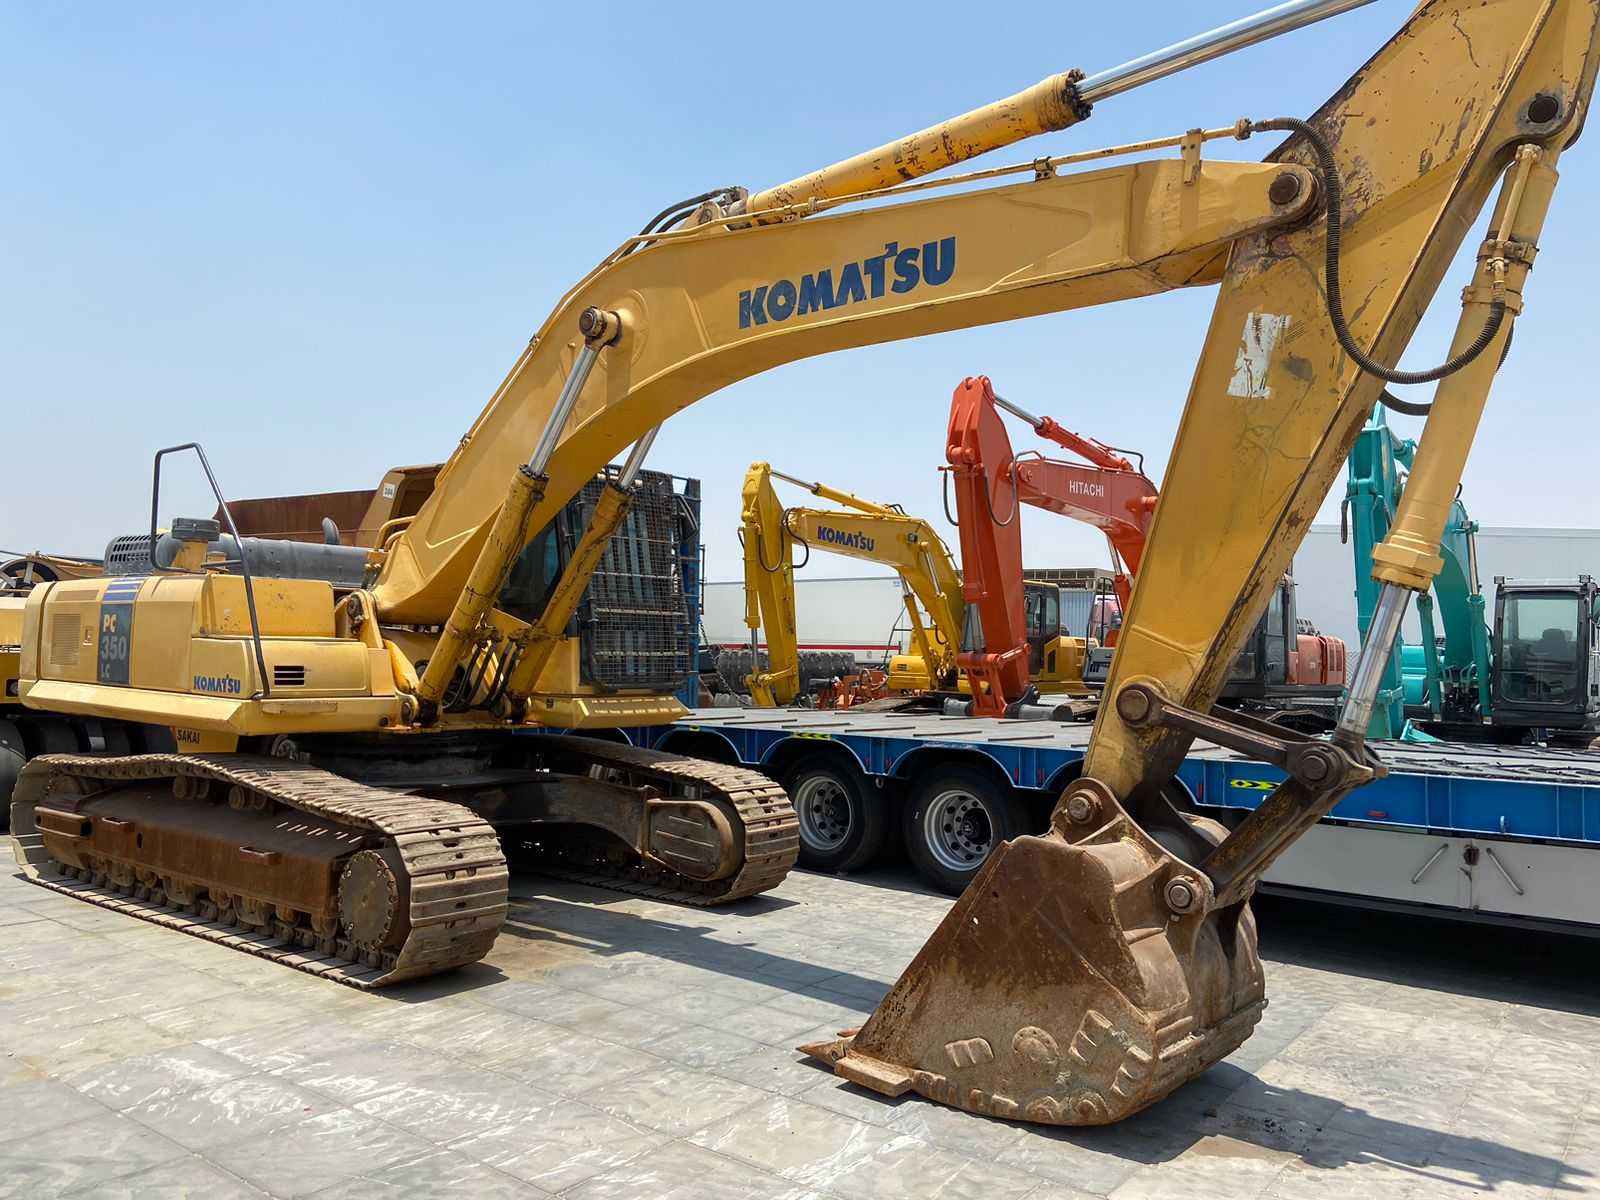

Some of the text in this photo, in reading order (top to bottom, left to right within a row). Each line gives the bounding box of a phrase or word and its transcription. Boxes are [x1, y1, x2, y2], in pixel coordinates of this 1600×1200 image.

[738, 236, 956, 329] KOMATSU
[1069, 480, 1104, 497] HITACHI
[817, 525, 874, 551] KOMATSU
[103, 614, 117, 633] PC
[101, 636, 127, 660] 350
[193, 673, 241, 694] KOMATSU
[176, 729, 200, 745] SAKAI
